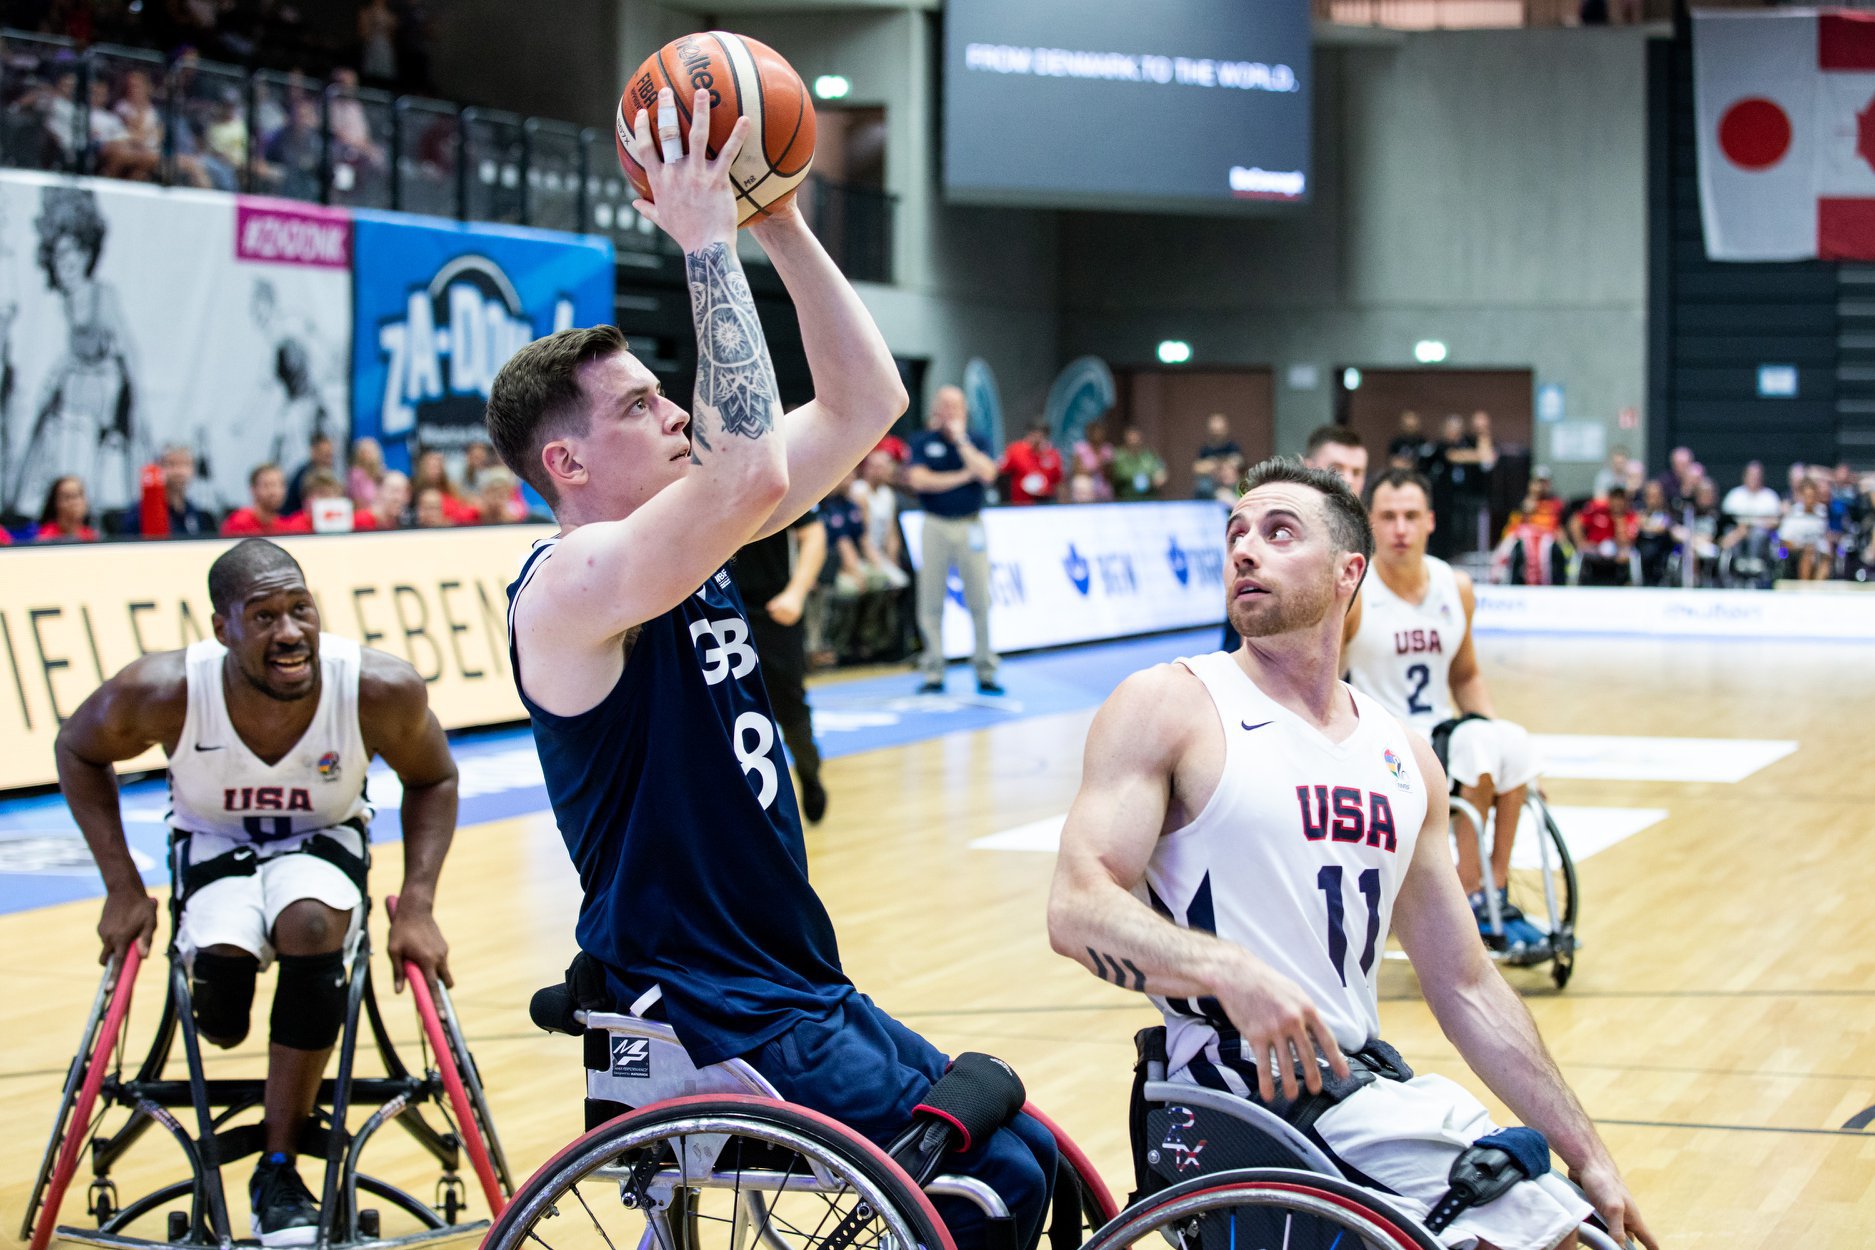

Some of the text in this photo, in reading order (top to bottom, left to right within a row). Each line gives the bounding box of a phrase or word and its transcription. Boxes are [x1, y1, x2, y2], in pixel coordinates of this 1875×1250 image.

[636, 72, 659, 109] FIBA
[965, 43, 1031, 74] FROM
[1032, 47, 1142, 82] DENMARK
[1142, 54, 1173, 84] TO
[1174, 56, 1217, 87] THE
[689, 616, 759, 686] GB
[1395, 628, 1443, 655] USA
[1406, 662, 1433, 714] 2
[733, 711, 778, 811] 8
[223, 787, 315, 812] USA
[1295, 784, 1398, 853] USA
[1317, 865, 1382, 988] 11
